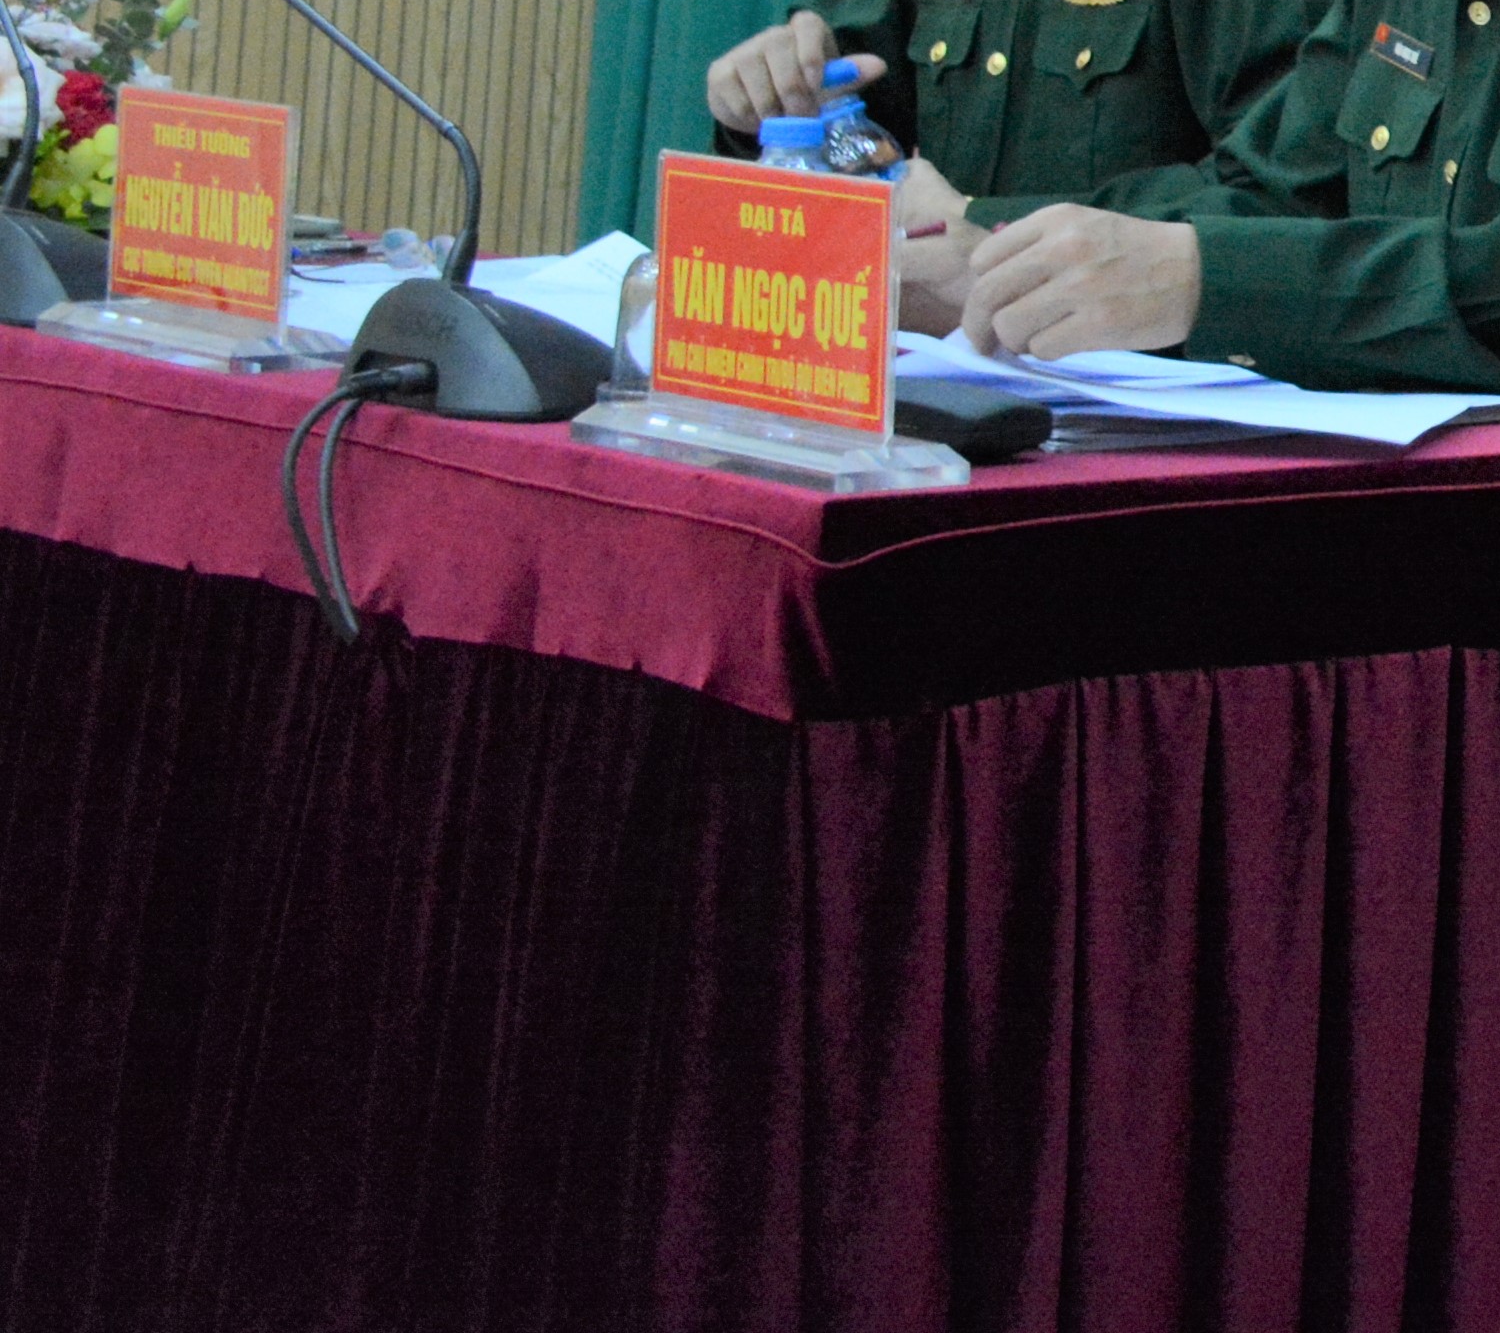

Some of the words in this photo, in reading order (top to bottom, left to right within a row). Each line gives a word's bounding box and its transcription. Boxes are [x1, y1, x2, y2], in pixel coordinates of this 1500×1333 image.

[124, 160, 195, 238] NGUYỄN
[198, 174, 235, 245] VĂN
[237, 181, 275, 252] ĐỨC
[739, 201, 775, 237] ĐẠI
[779, 204, 807, 238] TÁ
[672, 244, 726, 326] VĂN
[731, 264, 807, 351] NGỌC
[813, 264, 873, 352] QUẾ
